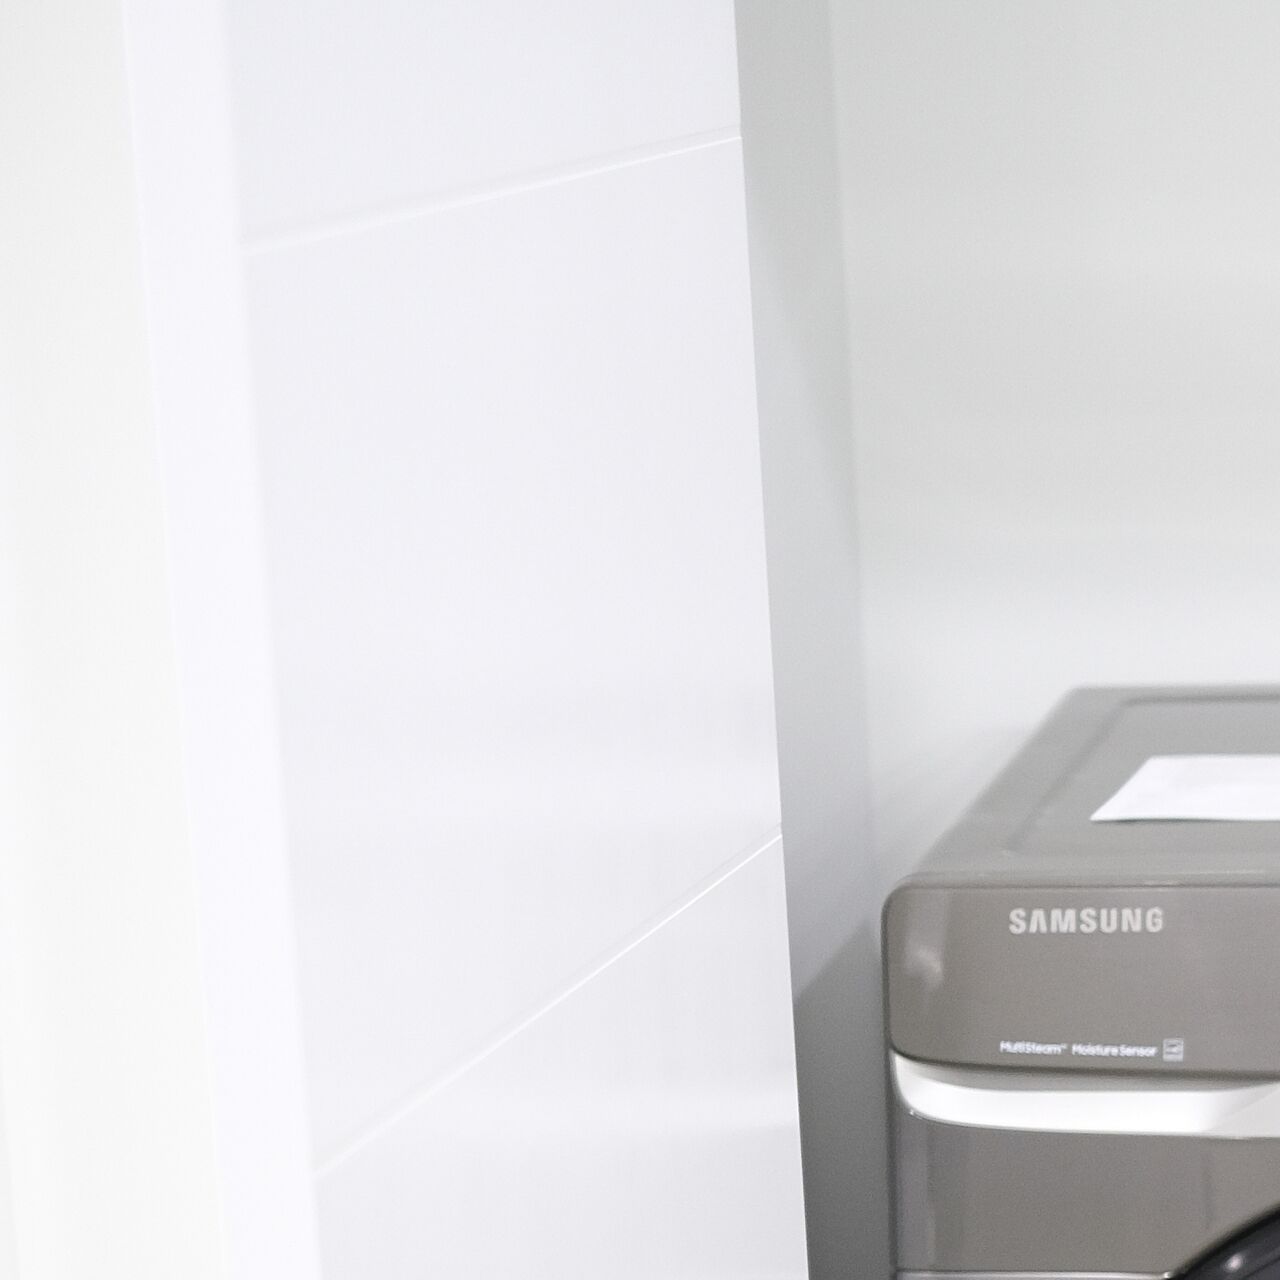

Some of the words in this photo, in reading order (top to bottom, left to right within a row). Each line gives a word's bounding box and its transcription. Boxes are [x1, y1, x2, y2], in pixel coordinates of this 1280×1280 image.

[1009, 906, 1164, 935] SAMSUNG
[1072, 1042, 1118, 1056] Moisture
[1119, 1045, 1157, 1057] Sensor
